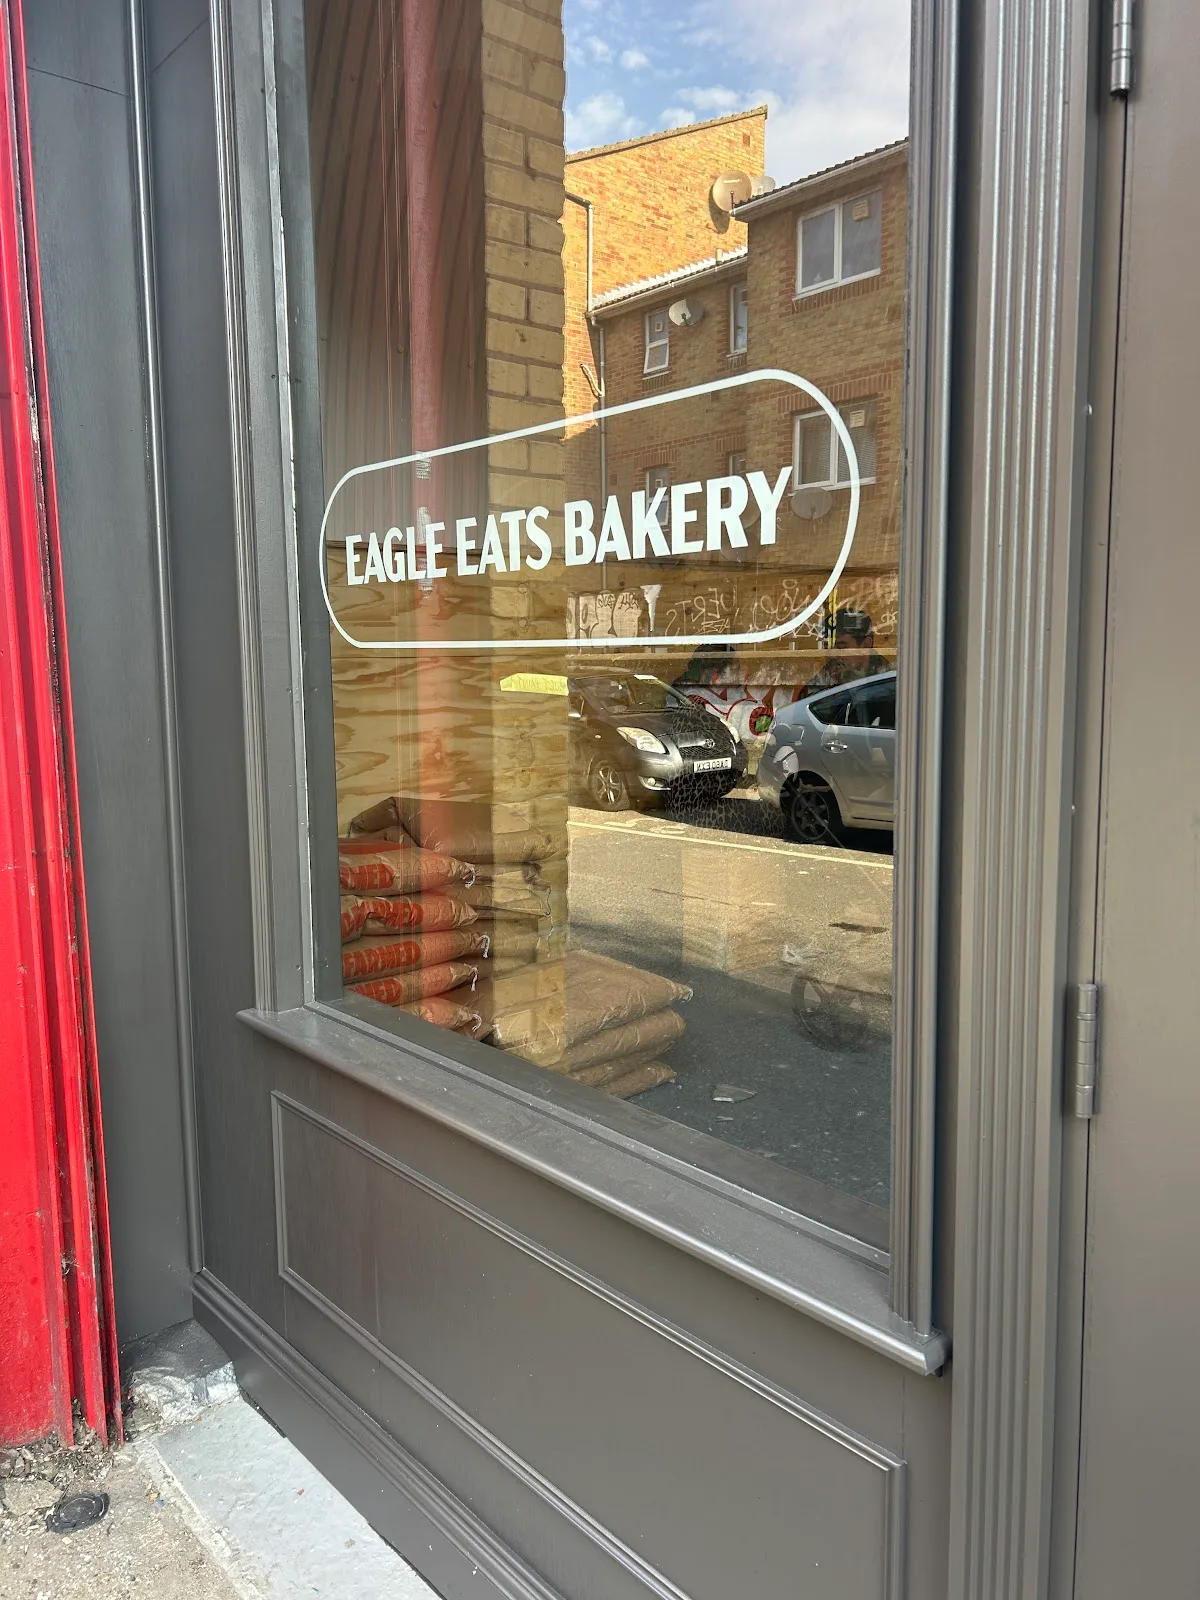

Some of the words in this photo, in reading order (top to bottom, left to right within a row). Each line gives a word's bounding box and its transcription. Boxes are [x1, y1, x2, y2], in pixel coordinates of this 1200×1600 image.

[346, 522, 447, 586] EAGLE
[456, 507, 551, 576] EATS
[565, 467, 792, 566] BAKERY
[343, 941, 421, 979] FARMED
